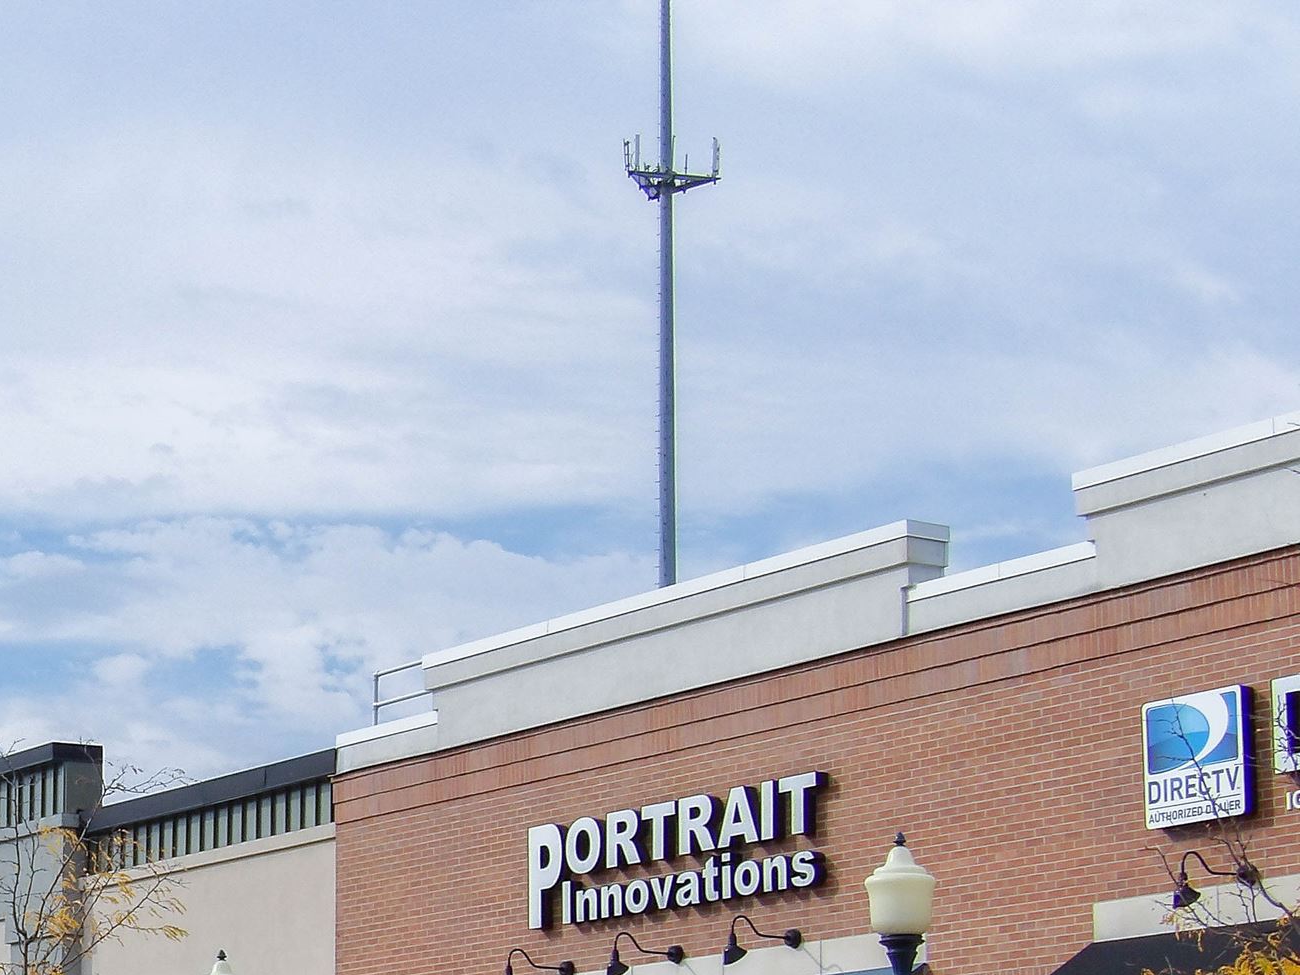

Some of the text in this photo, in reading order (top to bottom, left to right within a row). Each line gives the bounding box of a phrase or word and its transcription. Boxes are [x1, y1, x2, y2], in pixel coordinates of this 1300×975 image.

[1148, 766, 1240, 805] DIRECTV
[1149, 799, 1241, 824] AUTHORIZED DALER
[528, 771, 818, 930] PORTRAIT
[561, 850, 817, 925] Innovations
